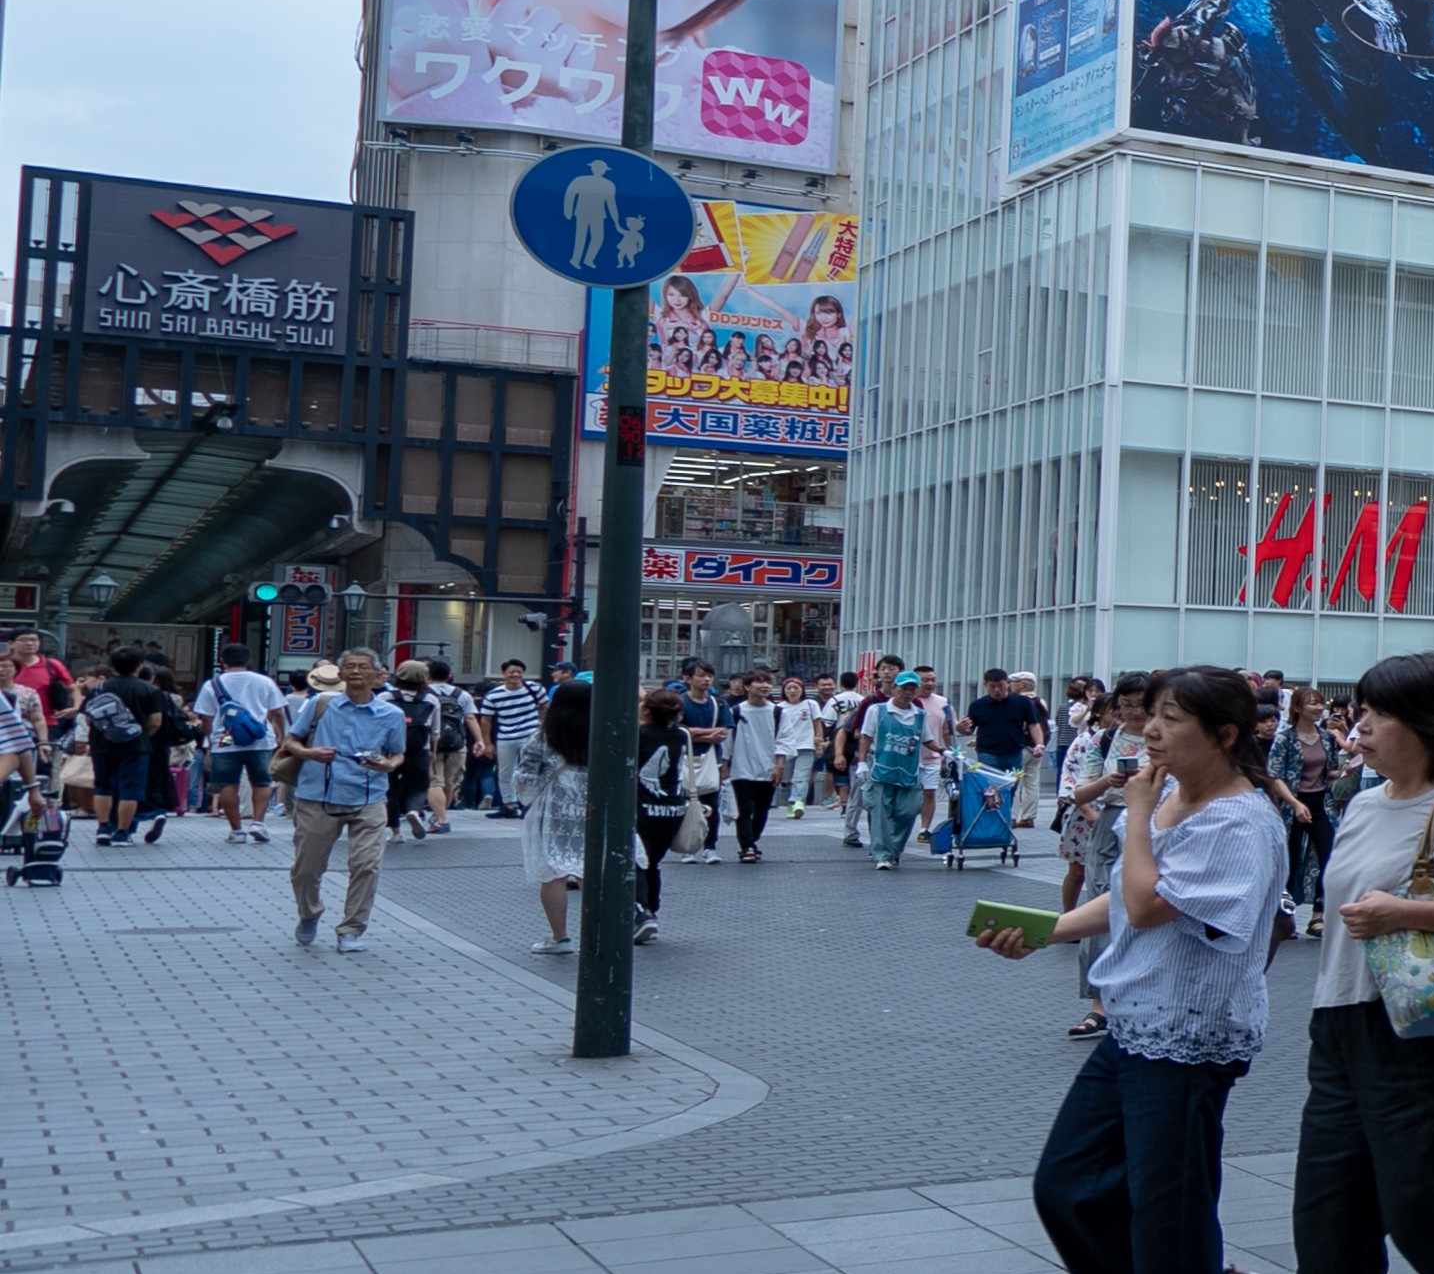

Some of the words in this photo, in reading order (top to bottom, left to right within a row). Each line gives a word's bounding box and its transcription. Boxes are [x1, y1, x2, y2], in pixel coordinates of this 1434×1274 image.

[418, 12, 687, 68] 恋愛マッチグ
[100, 263, 338, 324] 心斎橋筋
[100, 308, 151, 332] SHIN
[604, 366, 849, 413] タッフ大募集中!
[690, 555, 841, 588] ダイコク
[1238, 492, 1429, 612] H&M
